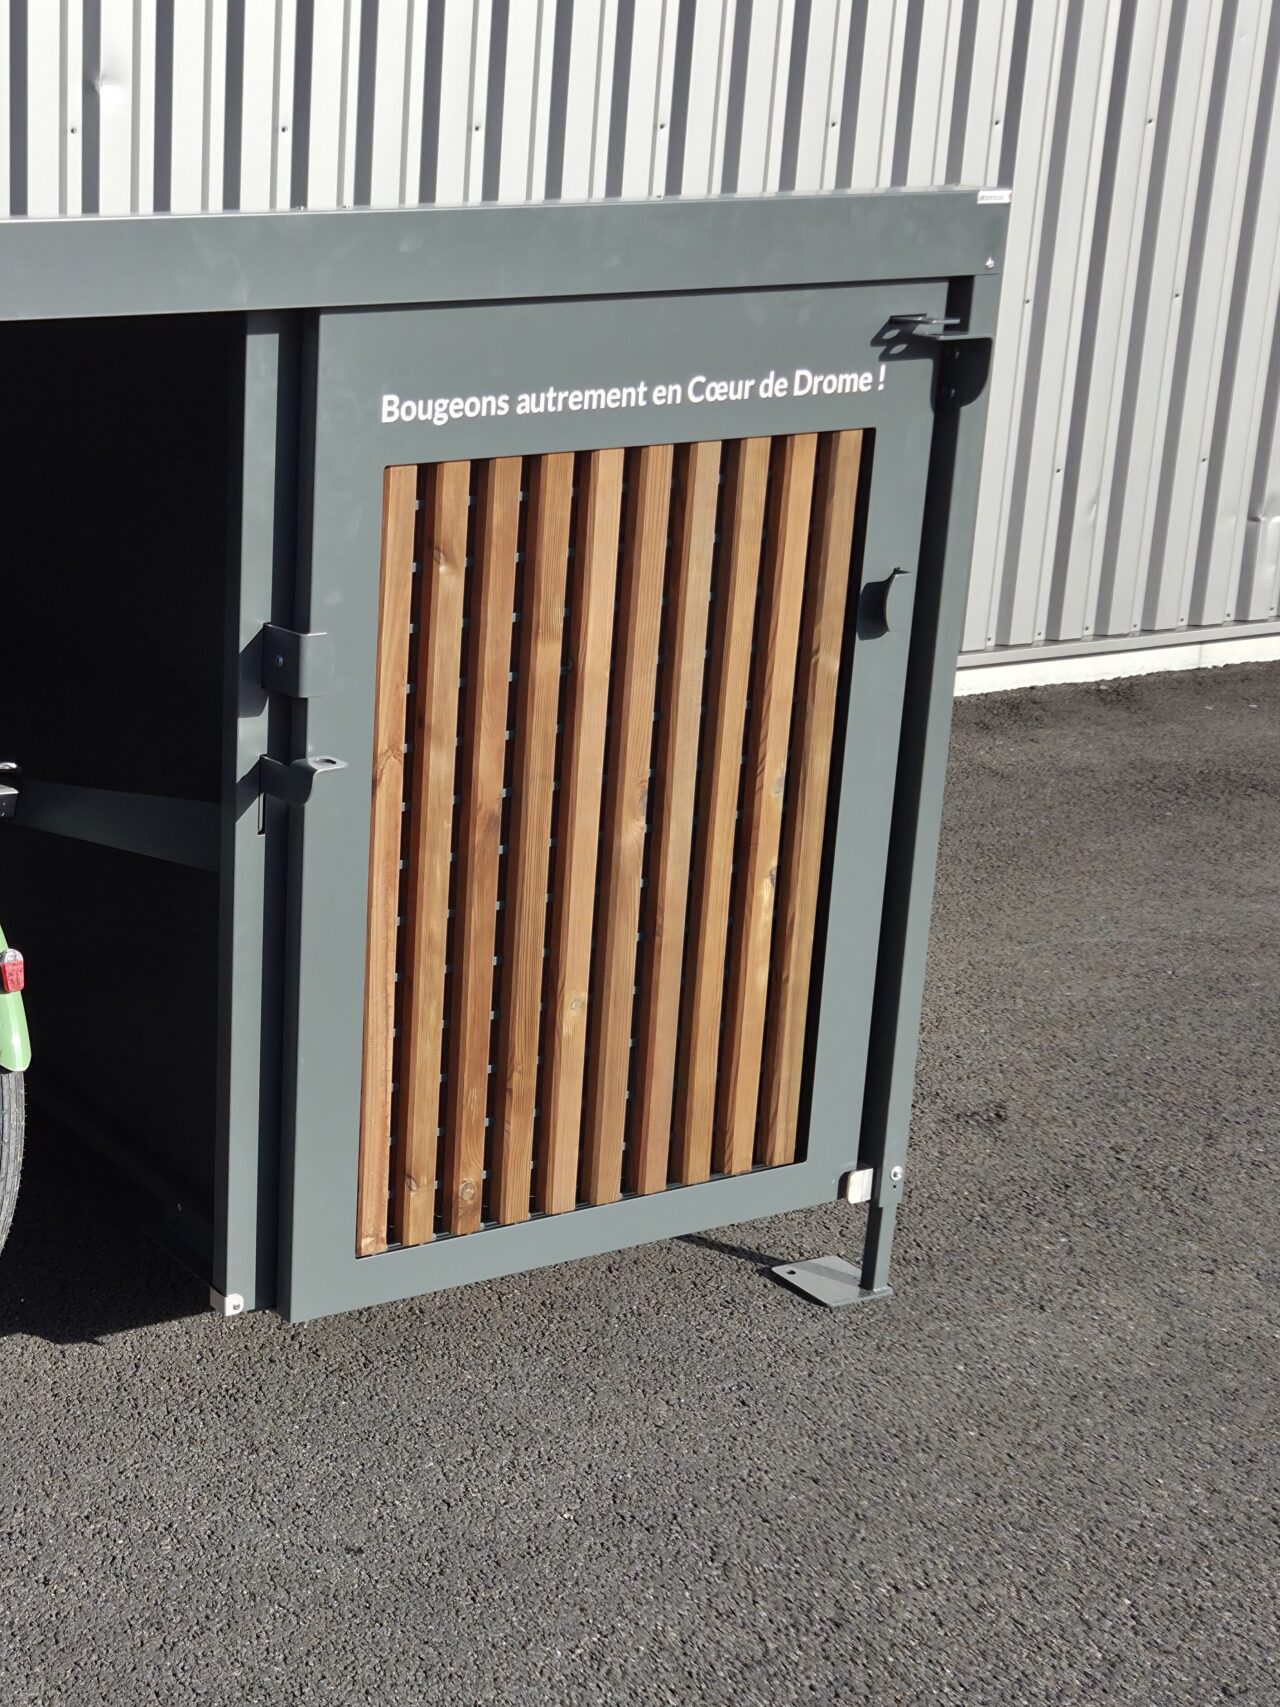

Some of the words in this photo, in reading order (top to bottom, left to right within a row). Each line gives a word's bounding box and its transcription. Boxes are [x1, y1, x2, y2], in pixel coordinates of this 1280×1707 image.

[381, 393, 510, 426] Bougeons
[516, 380, 648, 415] autrement
[652, 383, 682, 406] en
[687, 374, 755, 404] Cœur
[759, 370, 789, 399] de
